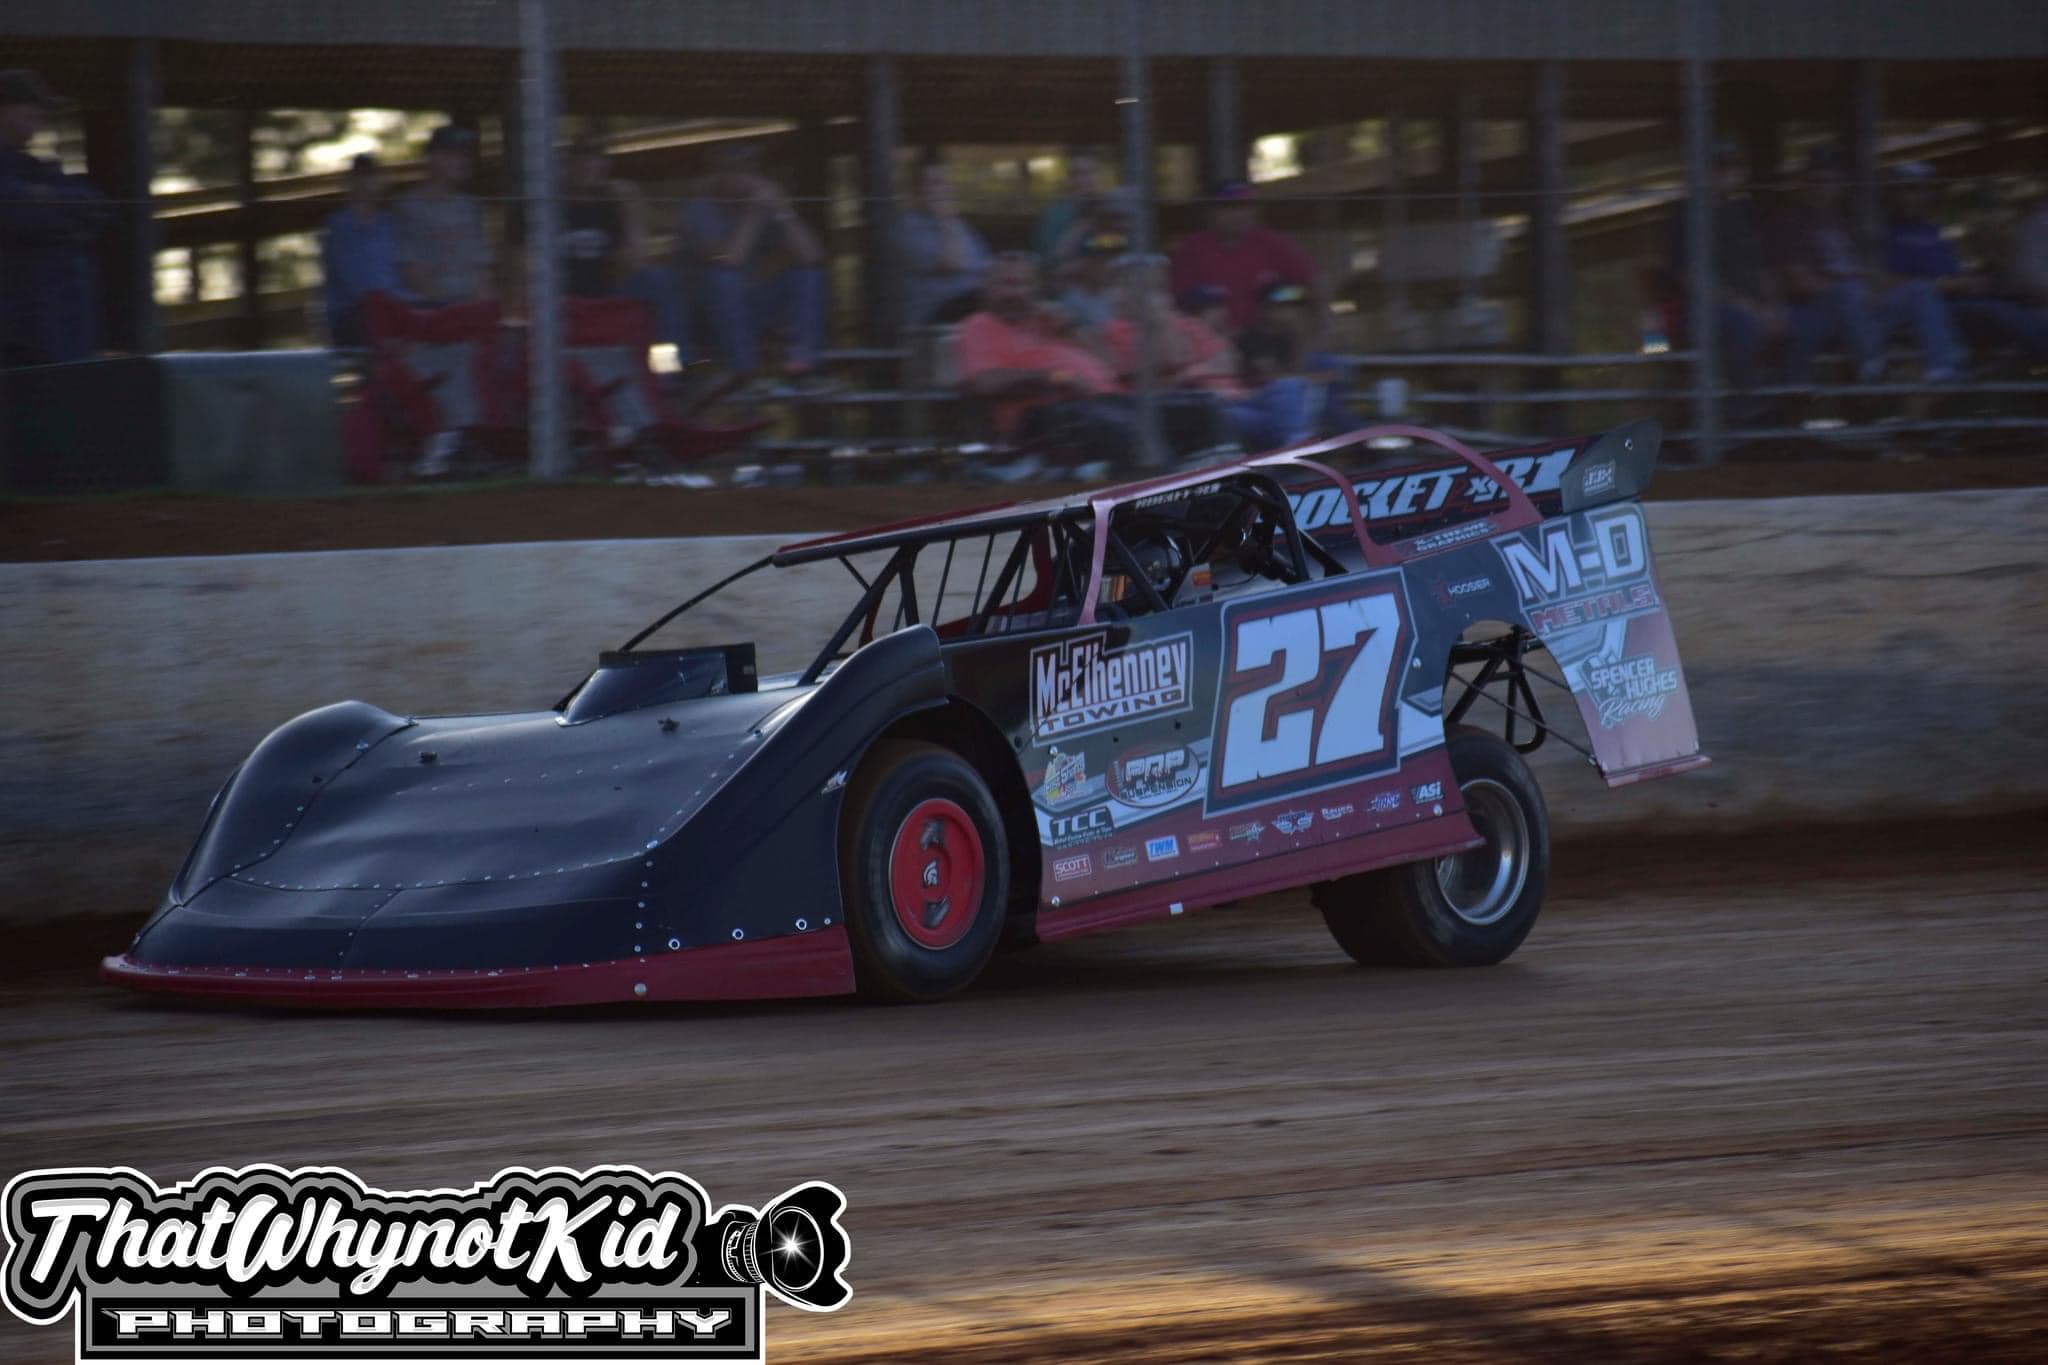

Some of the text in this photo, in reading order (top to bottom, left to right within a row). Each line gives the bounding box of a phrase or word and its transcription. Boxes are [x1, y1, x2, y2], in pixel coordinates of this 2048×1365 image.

[1503, 513, 1646, 600] M-D
[1447, 577, 1490, 596] HOOSIER
[1530, 584, 1652, 634] METALS
[1222, 592, 1400, 787] 27
[1591, 657, 1655, 690] SPENCER
[1625, 669, 1679, 700] HUGHES
[1044, 688, 1182, 732] TOWING
[1599, 694, 1666, 729] Racing
[1052, 807, 1107, 837] TCC
[1055, 857, 1088, 875] SCOTT
